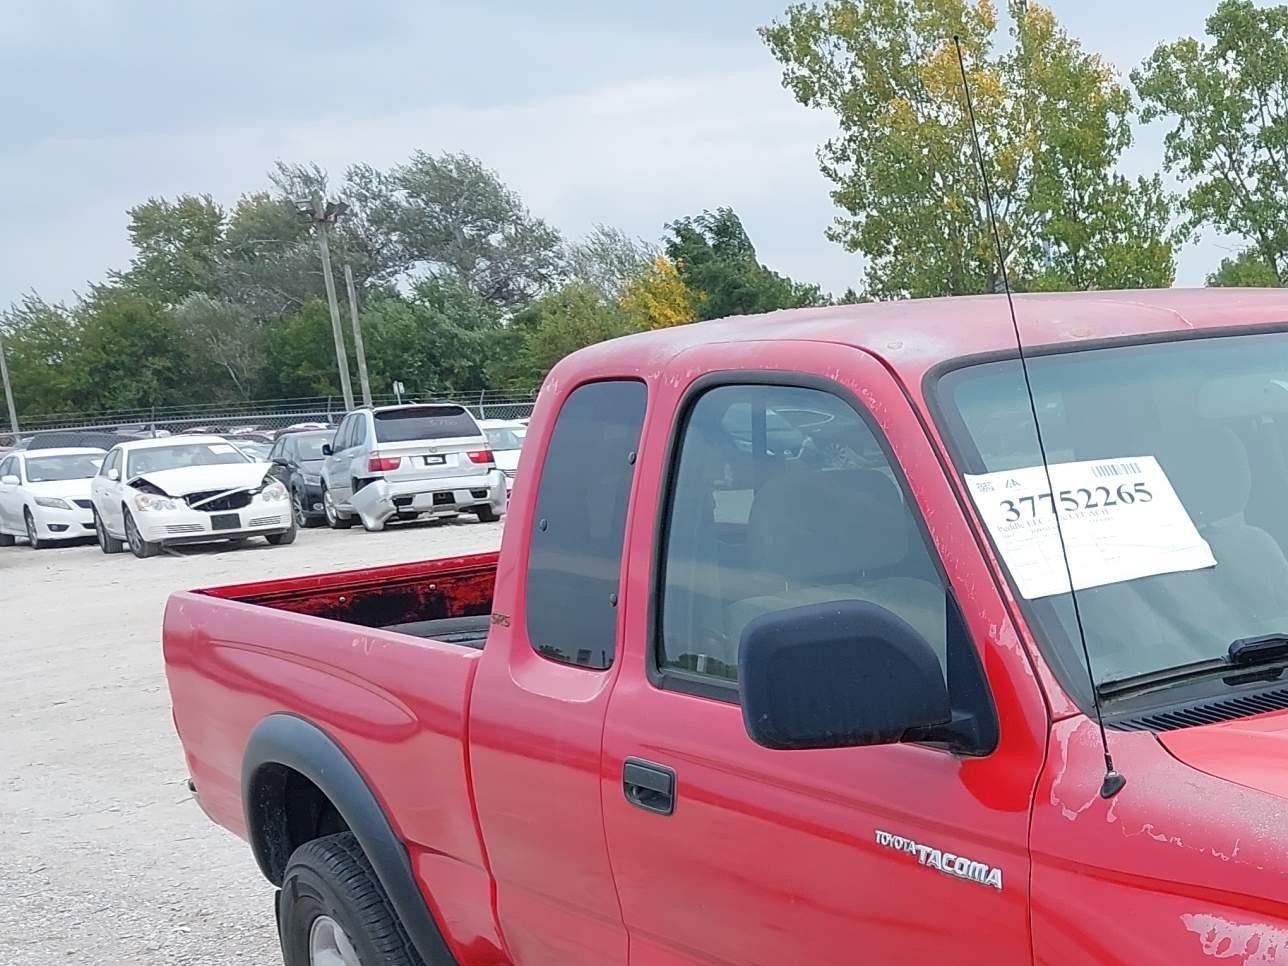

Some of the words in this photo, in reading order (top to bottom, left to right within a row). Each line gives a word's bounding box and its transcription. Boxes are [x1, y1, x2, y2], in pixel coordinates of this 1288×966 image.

[1000, 482, 1153, 523] 37752265
[874, 830, 917, 855] TOYOTA
[916, 845, 1003, 889] TACOMA
